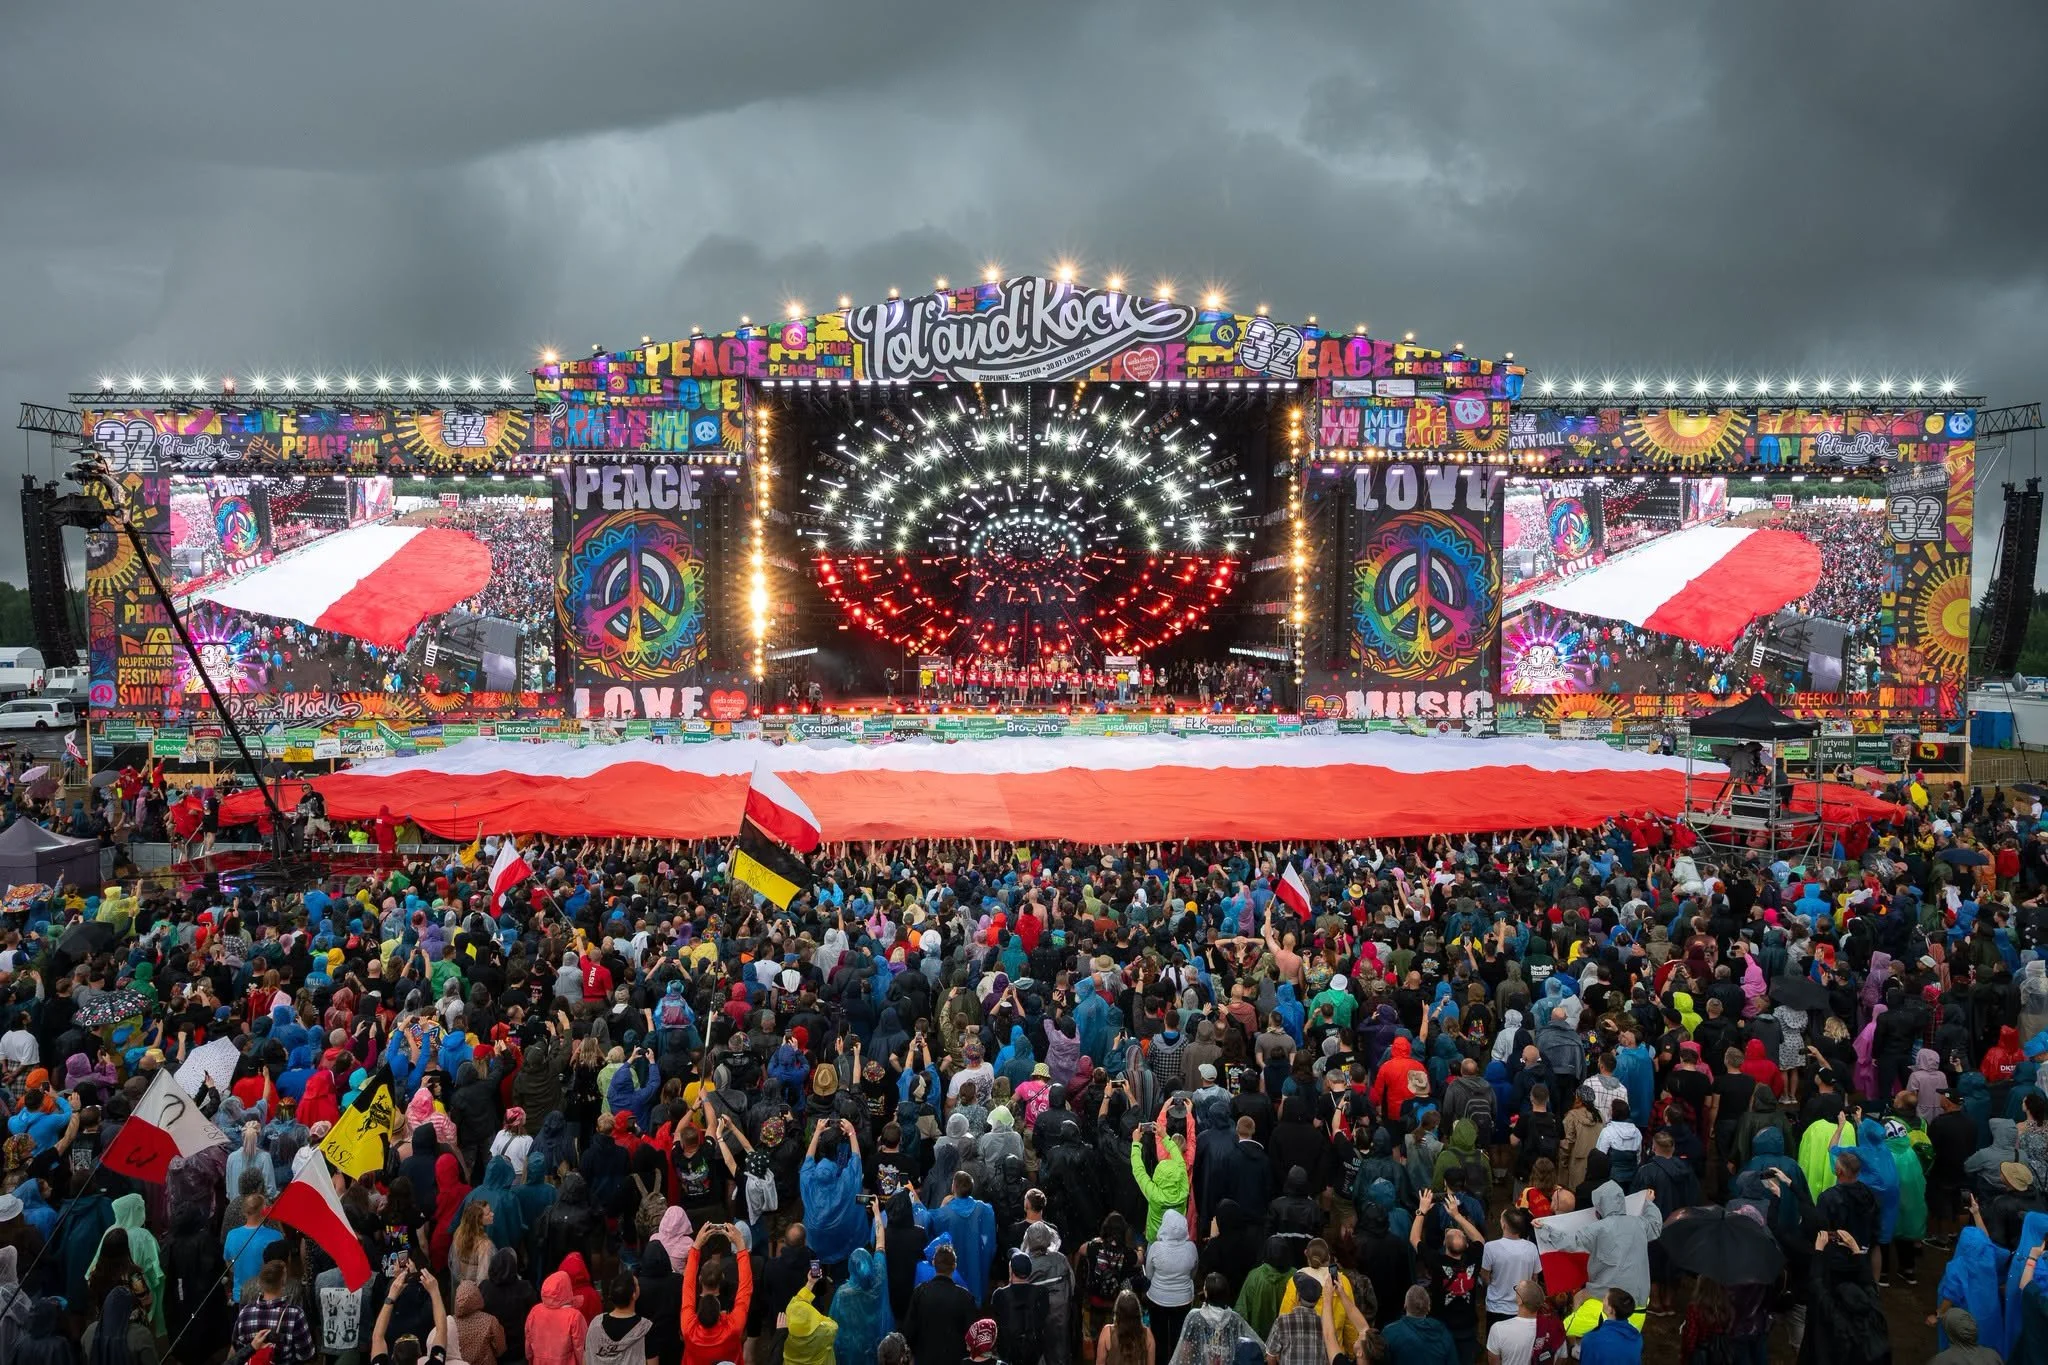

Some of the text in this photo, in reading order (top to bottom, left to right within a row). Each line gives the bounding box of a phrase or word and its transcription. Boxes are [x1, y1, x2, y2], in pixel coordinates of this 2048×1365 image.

[816, 343, 851, 354] PEACE
[1239, 318, 1304, 379] 32
[645, 338, 768, 377] PEACE
[817, 355, 851, 366] LOVE
[1297, 338, 1393, 377] EACE
[560, 361, 607, 374] PEACE
[609, 362, 644, 374] MUSIC
[769, 364, 816, 377] PEACE
[816, 368, 851, 378] MUSIC
[1187, 367, 1234, 378] PEACE
[1394, 361, 1443, 375] PEACE
[1443, 361, 1478, 373] MUSIC
[562, 378, 606, 390] MUSIC
[627, 379, 663, 394] OVE
[1445, 376, 1492, 389] PEACE
[610, 396, 665, 406] PEACE
[664, 378, 741, 410] LOVE
[229, 410, 298, 434] LOVE
[1364, 409, 1404, 427] MU
[440, 410, 487, 448] 32
[94, 418, 157, 473] 32
[1364, 428, 1404, 447] SIC
[1508, 432, 1565, 450] CK'N'ROLL
[282, 434, 347, 460] PEACE
[1744, 435, 1816, 465] LOVE
[575, 464, 701, 511] PEACE
[1354, 464, 1495, 511] LOVE
[1888, 496, 1942, 542] 32
[124, 603, 171, 624] PEAC
[200, 645, 227, 664] 32
[1530, 646, 1553, 664] 32
[574, 687, 704, 719] LOVE
[1664, 696, 1684, 706] JEST
[1879, 687, 1936, 707] MUSIC
[1345, 690, 1495, 722] MUSIC
[497, 724, 538, 735] Mierzęcin
[801, 723, 852, 736] Czaplinek
[1186, 717, 1207, 729] EŁK
[1209, 723, 1255, 735] zaplinek
[342, 729, 371, 738] Toruń
[1698, 743, 1711, 752] Żel
[1819, 740, 1850, 748] artynia
